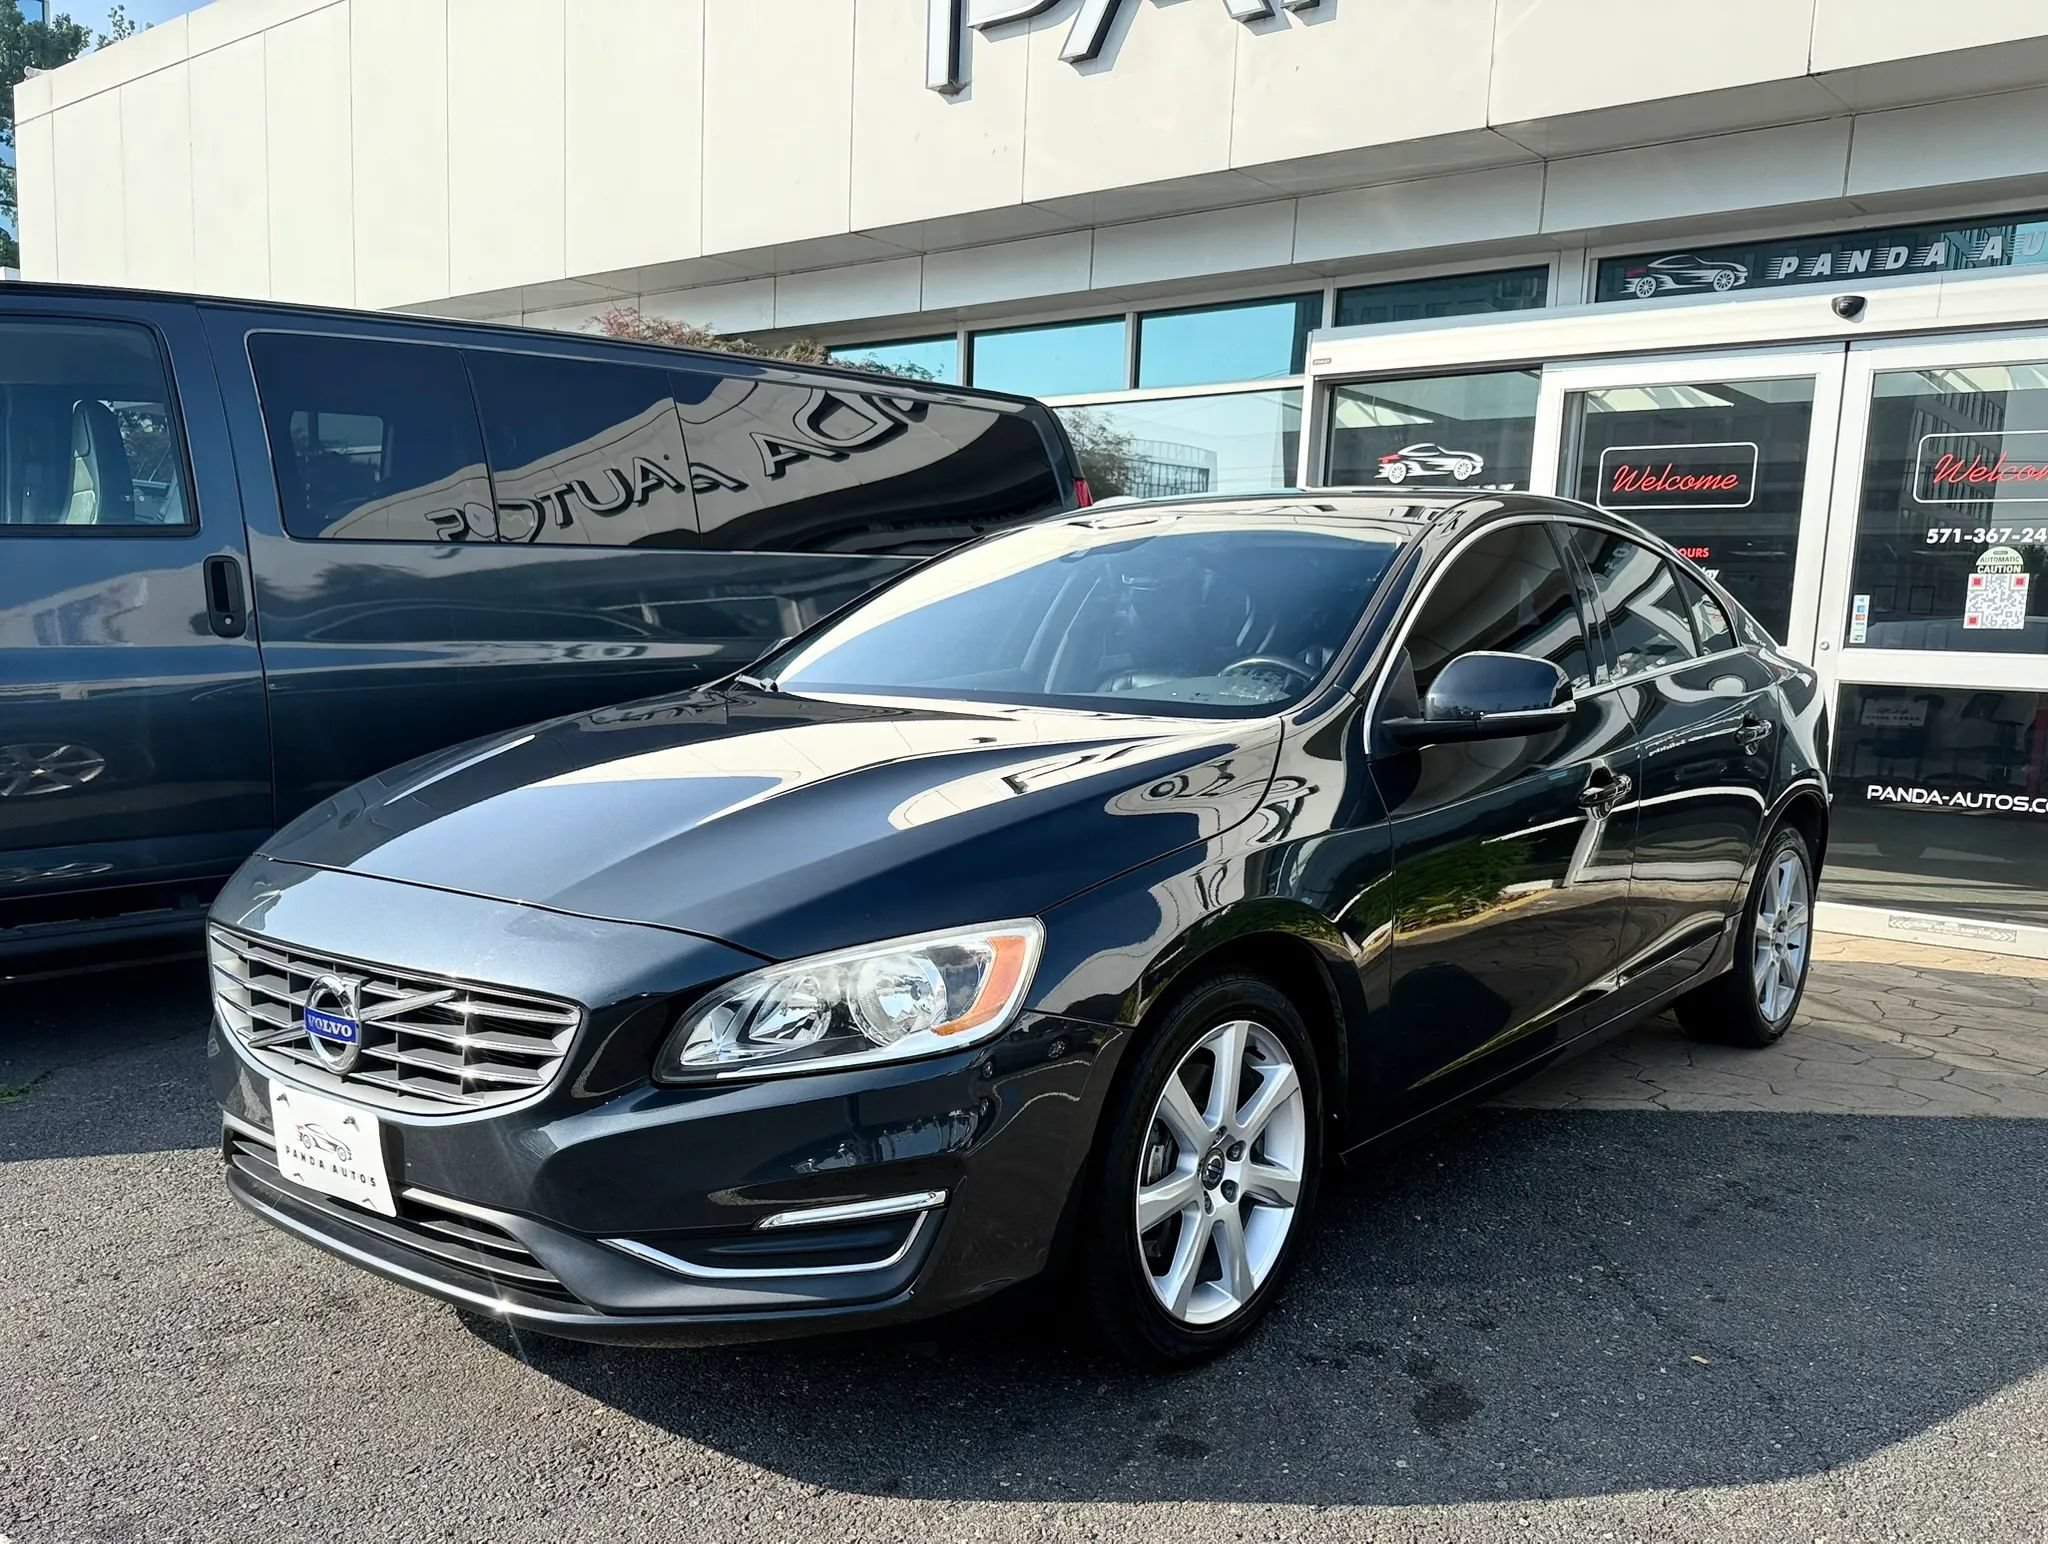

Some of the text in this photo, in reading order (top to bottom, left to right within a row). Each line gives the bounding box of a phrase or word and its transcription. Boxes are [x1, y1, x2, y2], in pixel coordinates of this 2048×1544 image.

[1766, 241, 1946, 280] PANDA
[1612, 463, 1739, 492] Welcome
[1933, 452, 2048, 485] Welco
[1926, 527, 2048, 544] 571-367-24
[1677, 547, 1710, 558] OURS
[1977, 565, 2021, 574] CAUTION
[1867, 785, 2048, 814] PANDA-AUTOS.C
[307, 1013, 353, 1038] VOLVO
[284, 1145, 376, 1188] PANDA AUTOS
